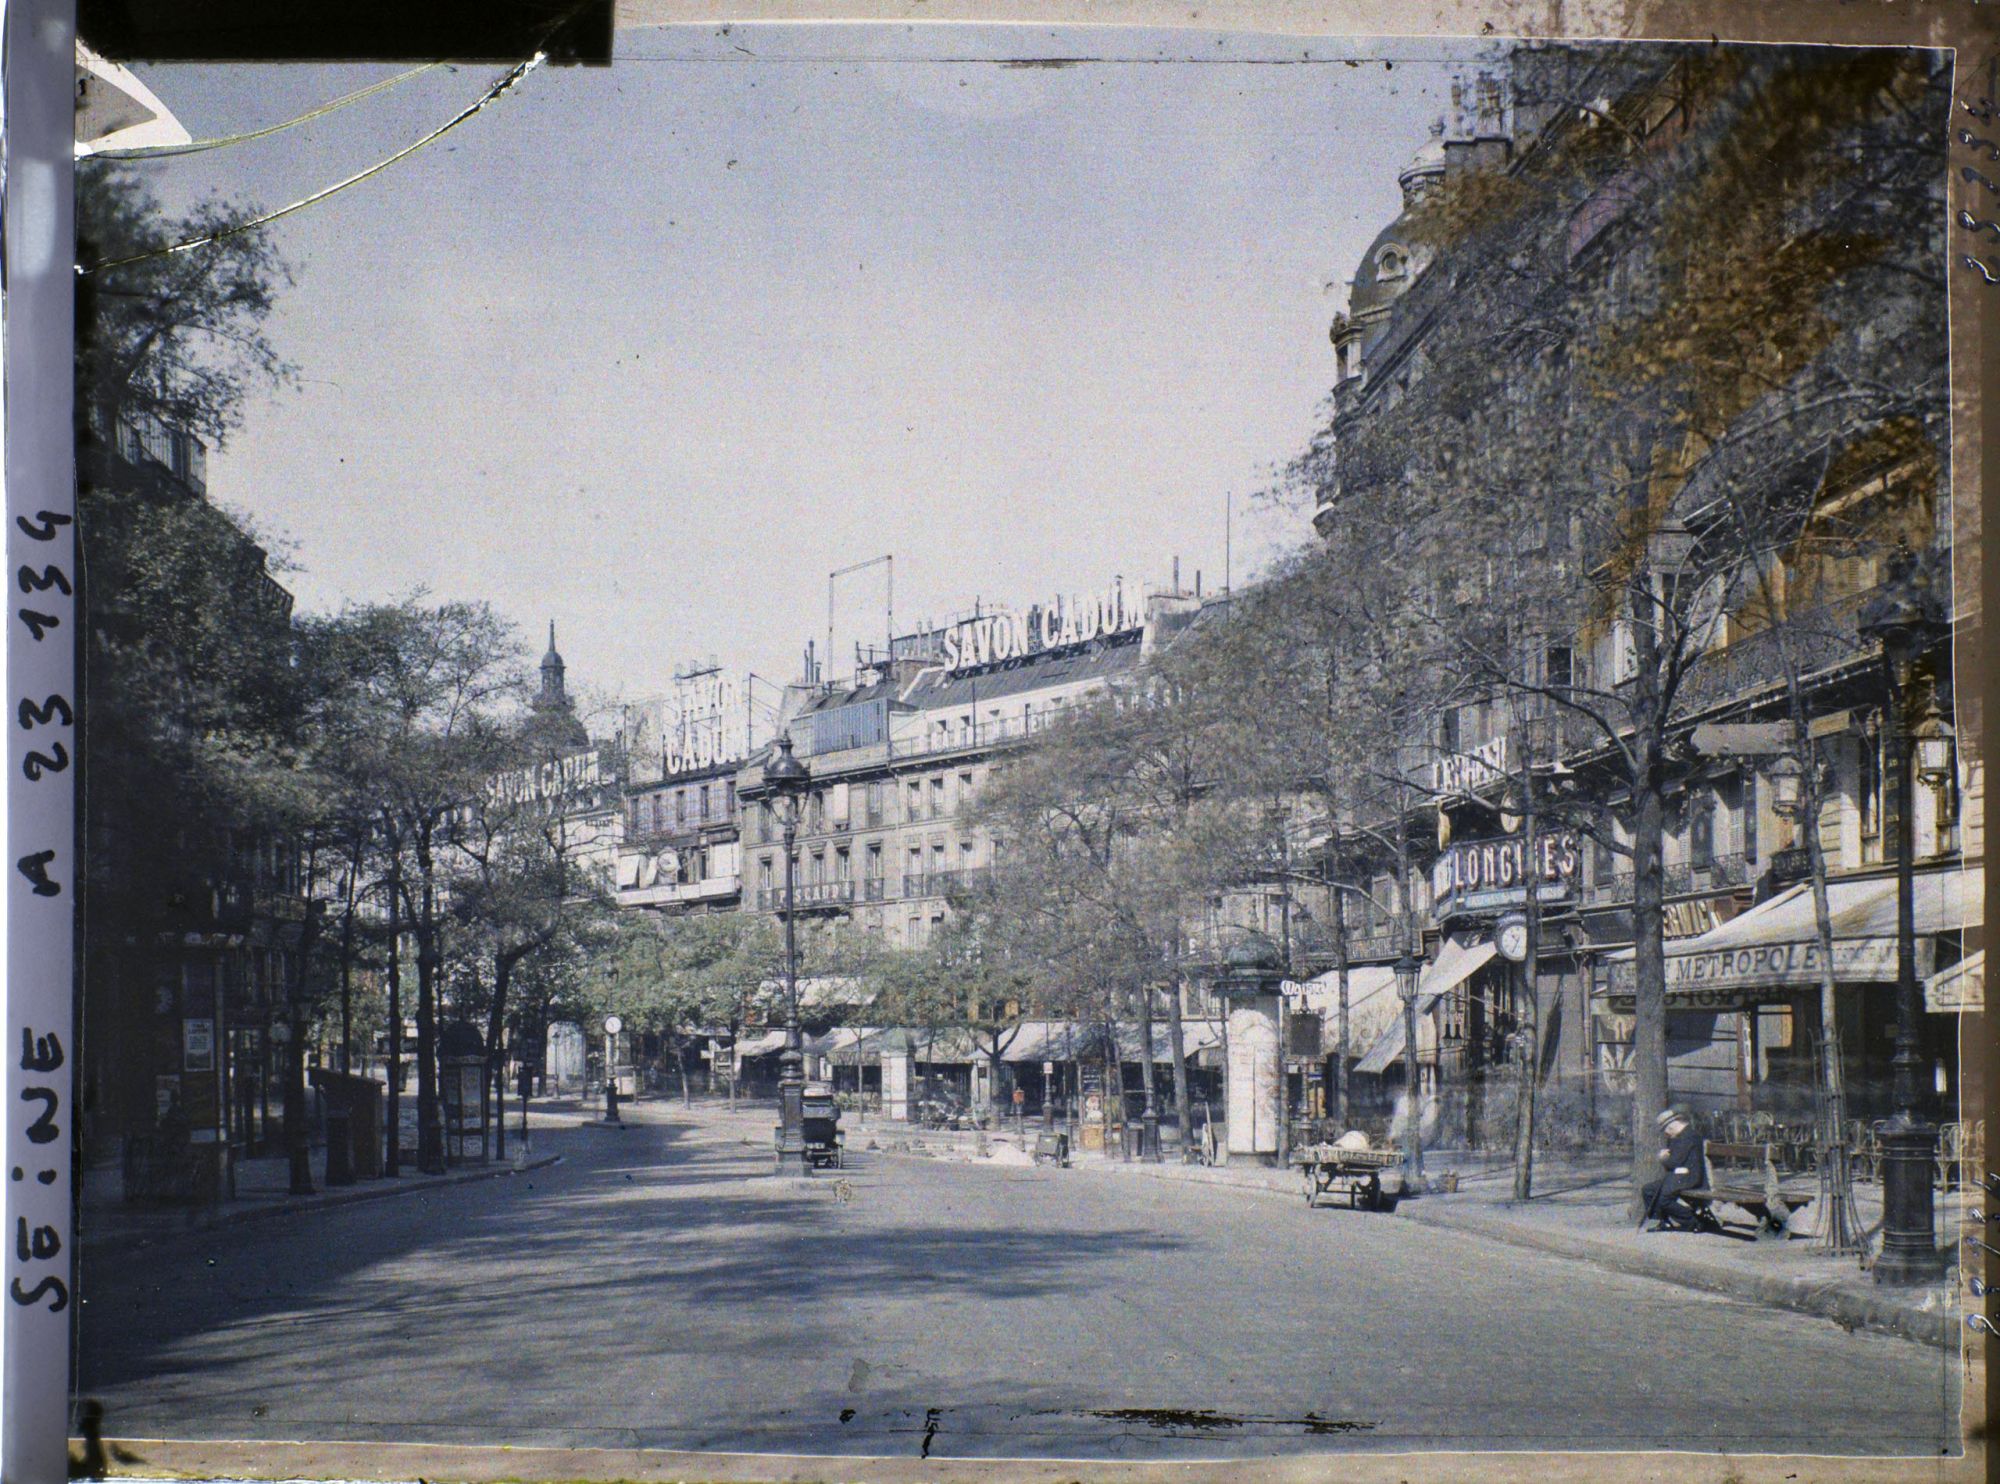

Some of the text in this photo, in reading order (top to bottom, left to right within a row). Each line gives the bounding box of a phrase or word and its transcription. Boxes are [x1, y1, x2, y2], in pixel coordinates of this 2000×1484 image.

[16, 510, 72, 642] 134
[943, 575, 1147, 672] SAVON CADUM
[18, 694, 73, 781] 23
[17, 849, 61, 897] A
